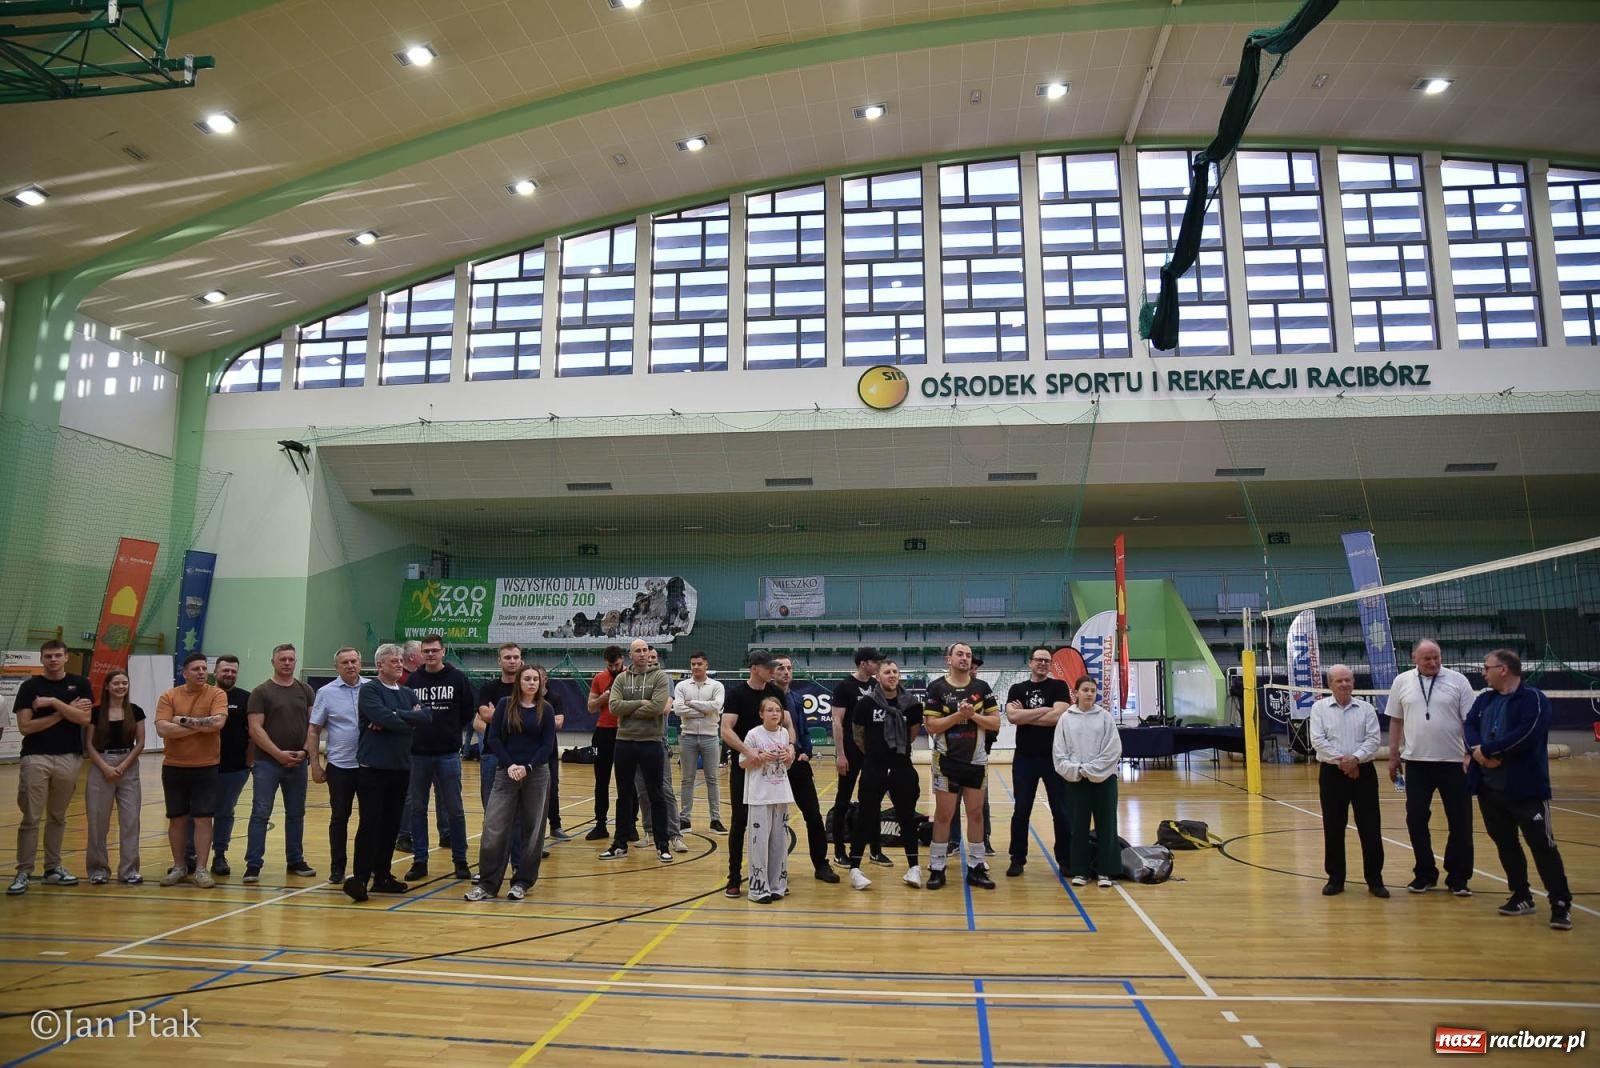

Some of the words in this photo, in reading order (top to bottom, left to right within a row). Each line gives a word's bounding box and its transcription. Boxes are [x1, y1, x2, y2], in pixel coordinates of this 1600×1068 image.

[921, 372, 1037, 397] OŚRODEK
[1046, 371, 1142, 394] SPORTU
[1152, 371, 1158, 392] I
[1168, 368, 1297, 391] REKREACJI
[1307, 361, 1431, 388] RACIBÓRZ
[503, 578, 561, 591] WSZYSTKO
[564, 578, 584, 591] DLA
[588, 577, 639, 590] TWOJEGO
[773, 578, 818, 589] MIESZKO
[438, 585, 487, 602] ZOO
[502, 593, 568, 607] DOMOWEGO
[572, 593, 596, 606] ZOO
[432, 602, 483, 617] MAR
[430, 686, 454, 700] STAR
